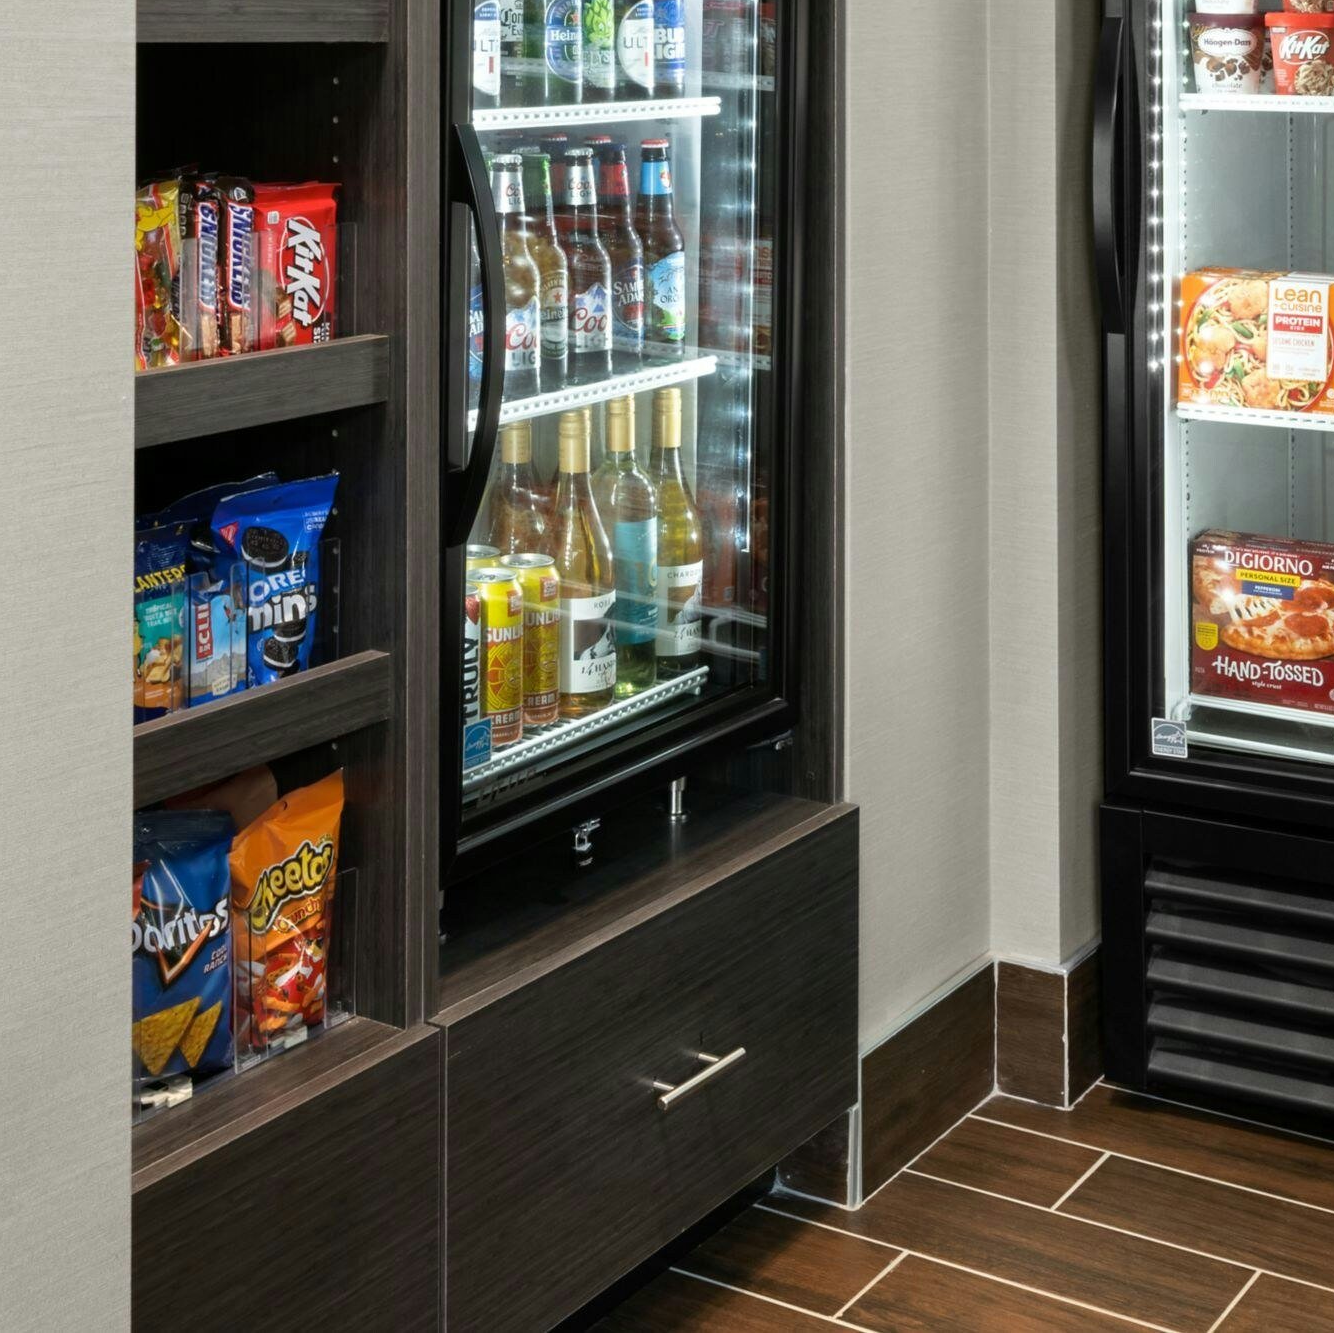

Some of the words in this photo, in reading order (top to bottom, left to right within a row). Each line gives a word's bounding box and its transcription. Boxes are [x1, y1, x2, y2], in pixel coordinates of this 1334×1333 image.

[1274, 287, 1323, 304] Lean
[1275, 316, 1321, 328] PROTEIN
[1224, 550, 1313, 577] DIGIORNO
[248, 567, 306, 604] ORE
[1240, 571, 1278, 583] PERSONAL
[1280, 576, 1297, 585] SIZE
[1212, 655, 1324, 688] HAND-TOSSED
[250, 840, 334, 934] Cheetos
